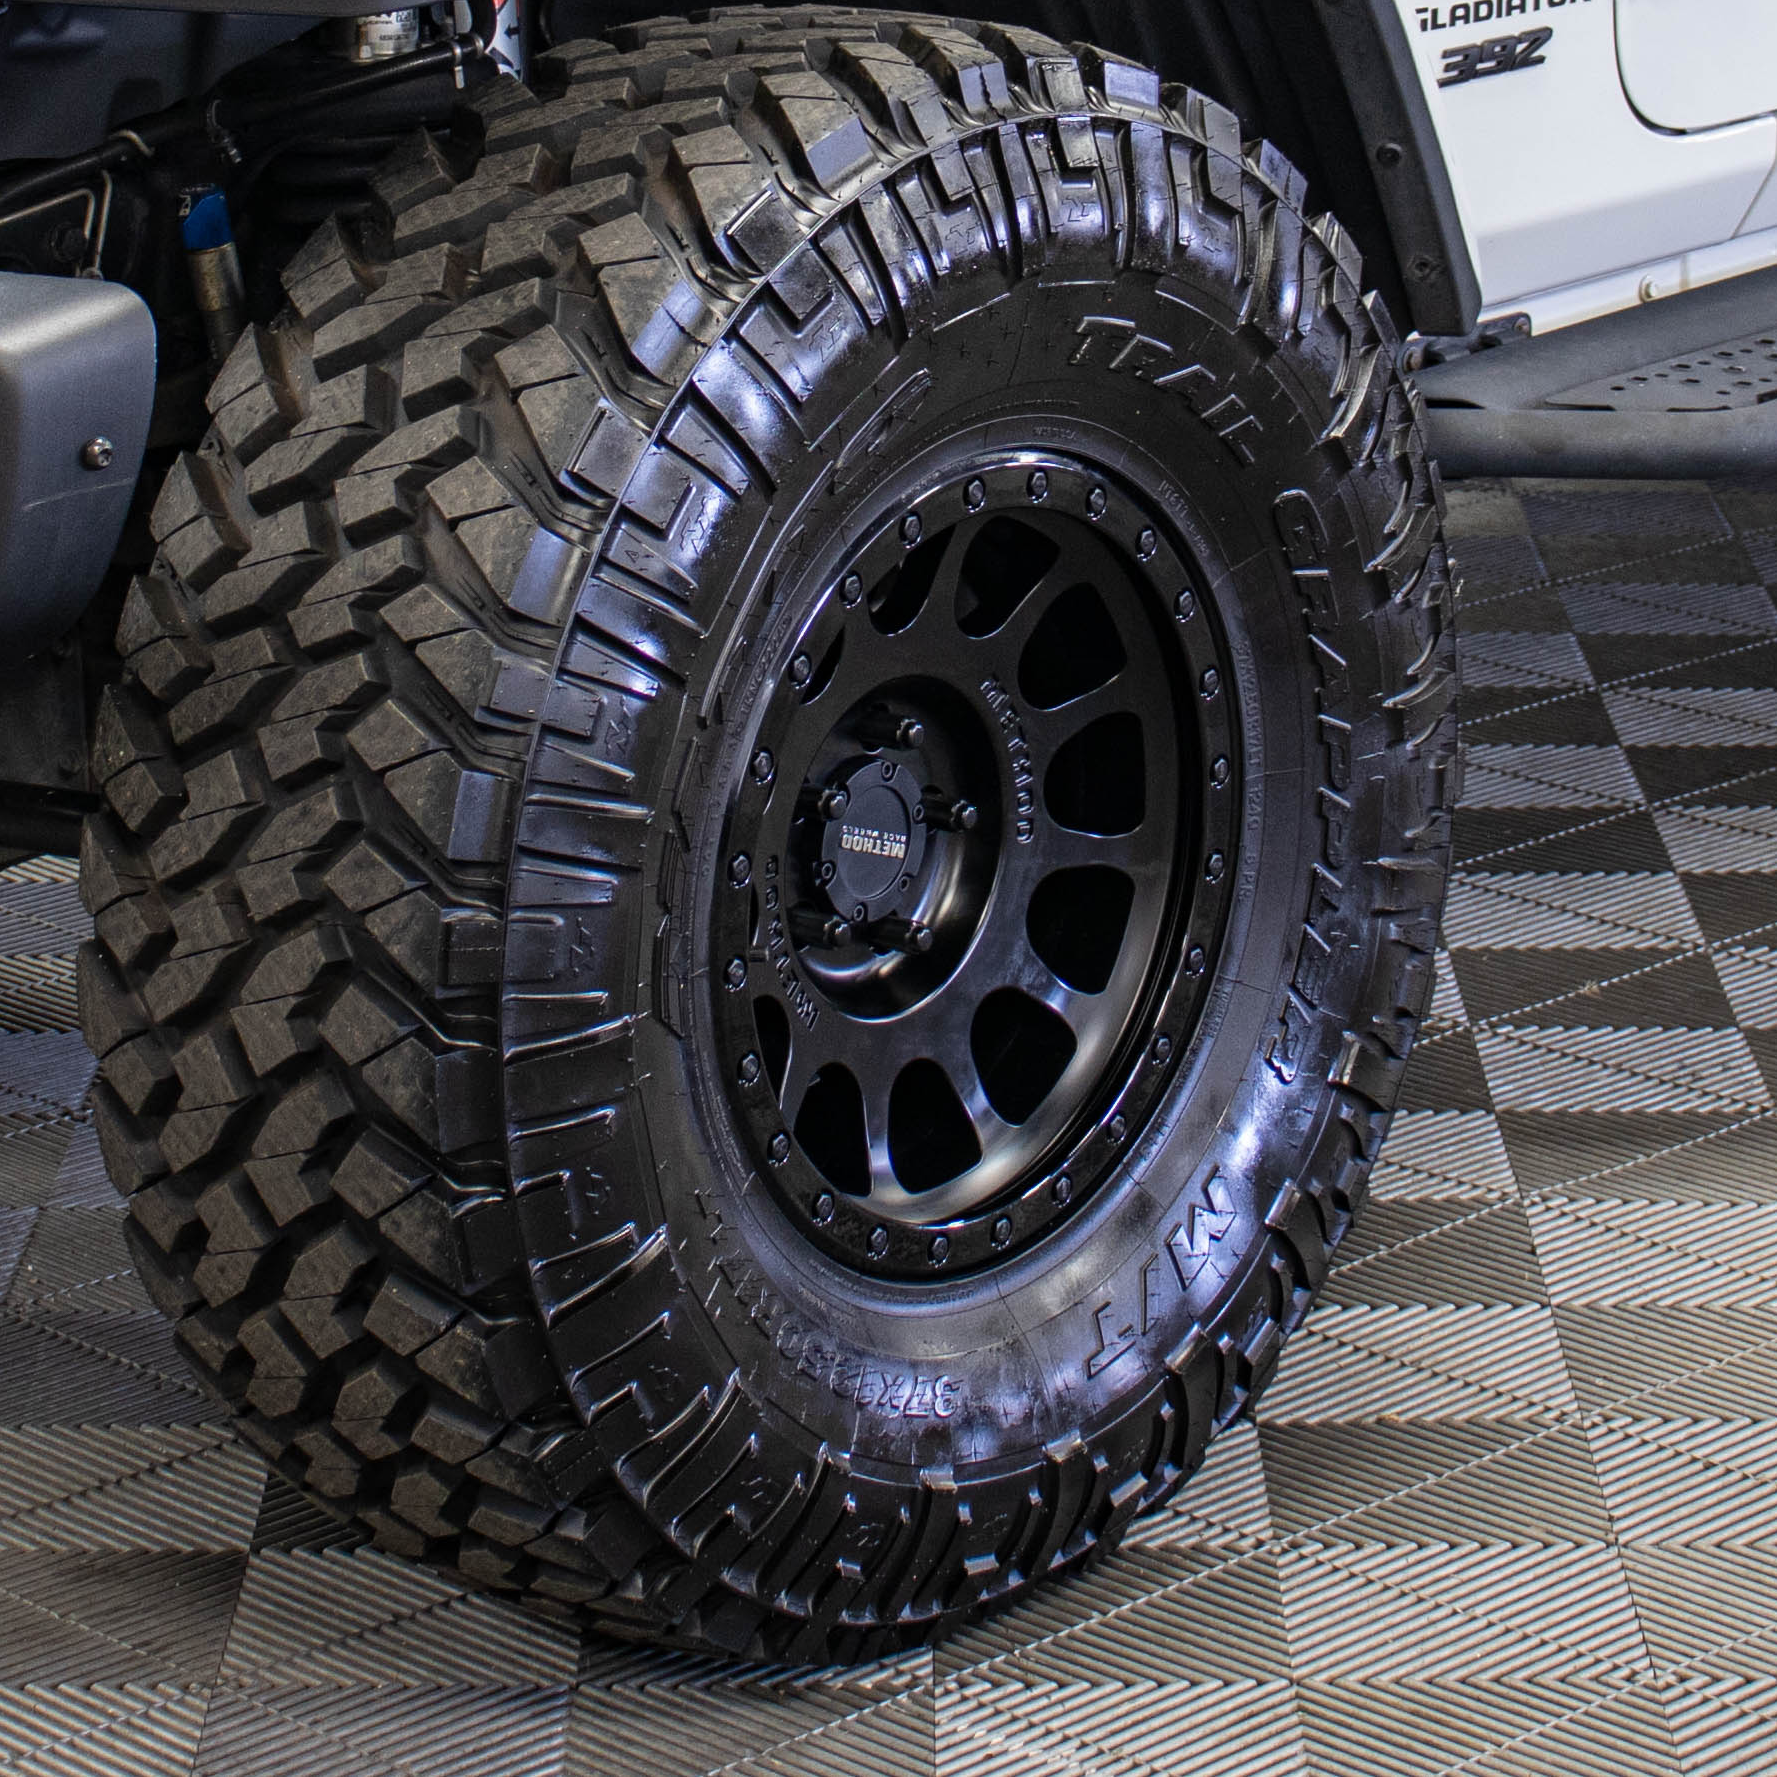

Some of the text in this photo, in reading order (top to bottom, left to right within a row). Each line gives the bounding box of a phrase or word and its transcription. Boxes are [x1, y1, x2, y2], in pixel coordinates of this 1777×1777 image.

[1436, 26, 1554, 89] 392
[1068, 315, 1264, 464] TRAIL
[979, 679, 1035, 844] METHOD
[1264, 487, 1352, 1085] GRAPPLER
[840, 832, 907, 860] METHOD
